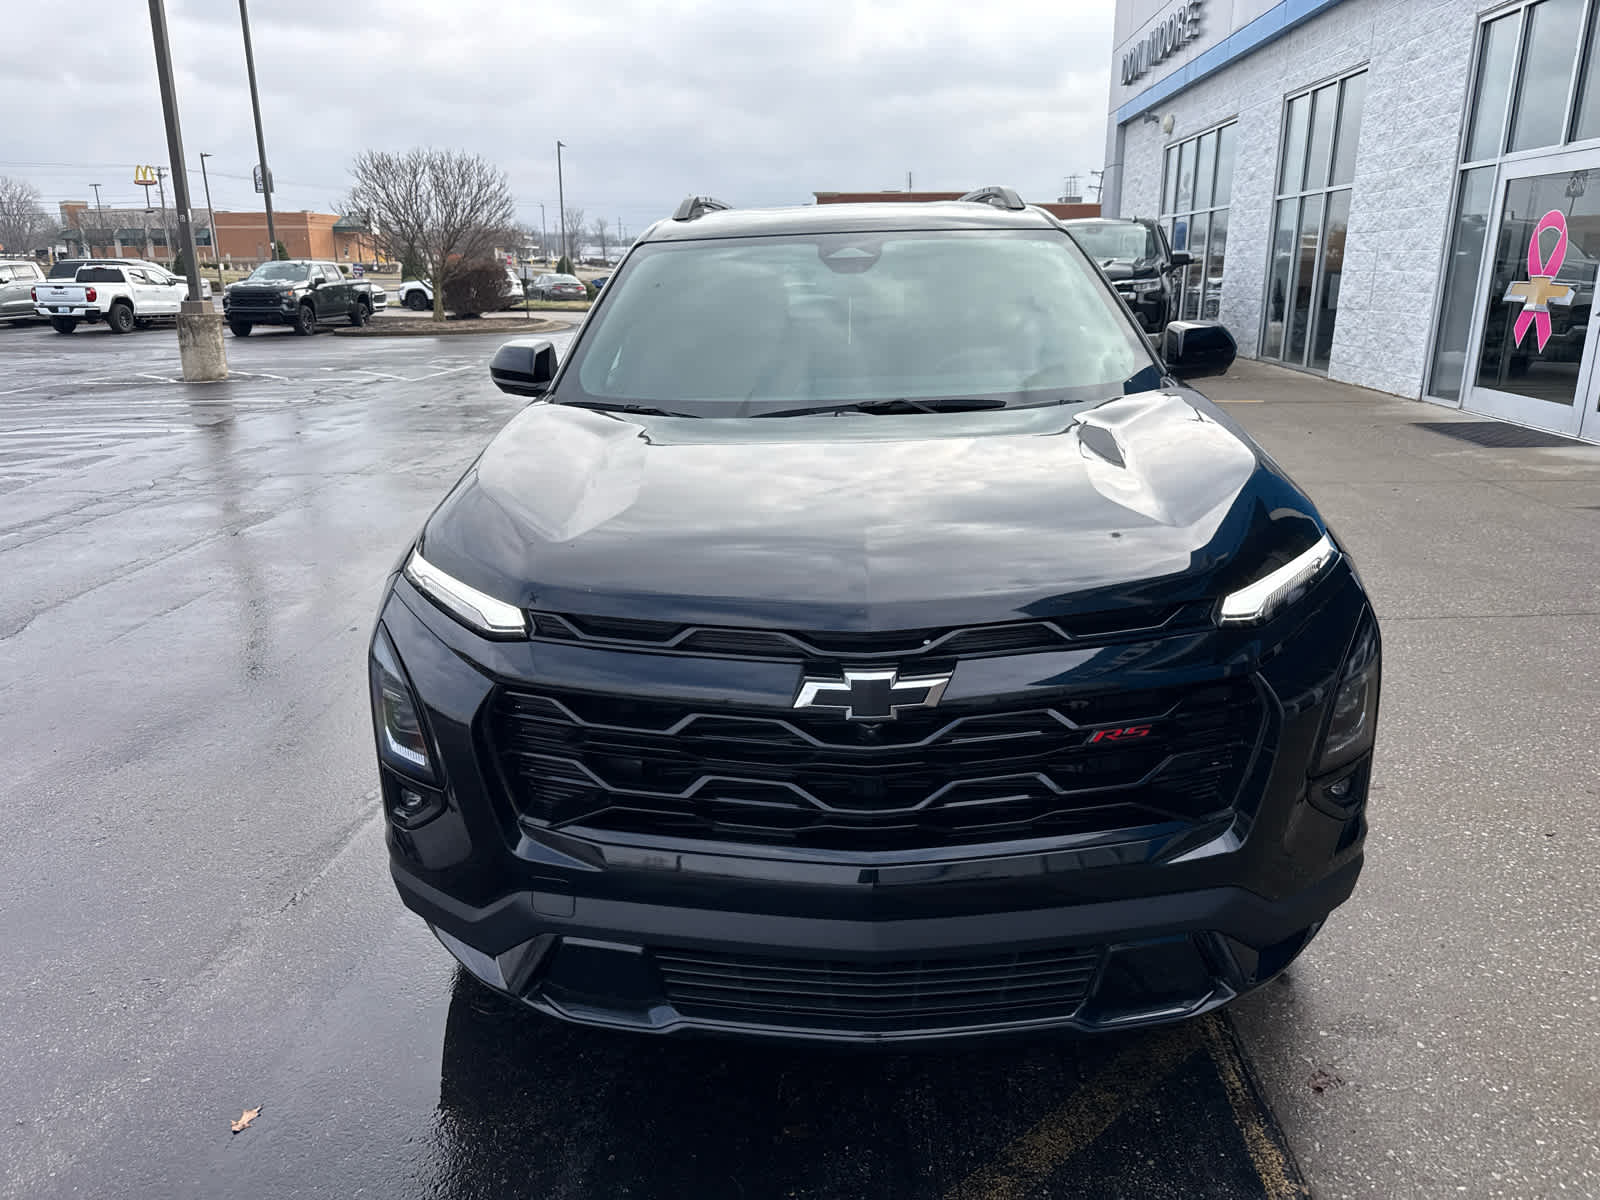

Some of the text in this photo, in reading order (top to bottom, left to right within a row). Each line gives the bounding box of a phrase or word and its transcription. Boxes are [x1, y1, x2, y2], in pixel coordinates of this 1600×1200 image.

[1120, 0, 1202, 86] DON MOORE
[1088, 724, 1152, 743] RS
